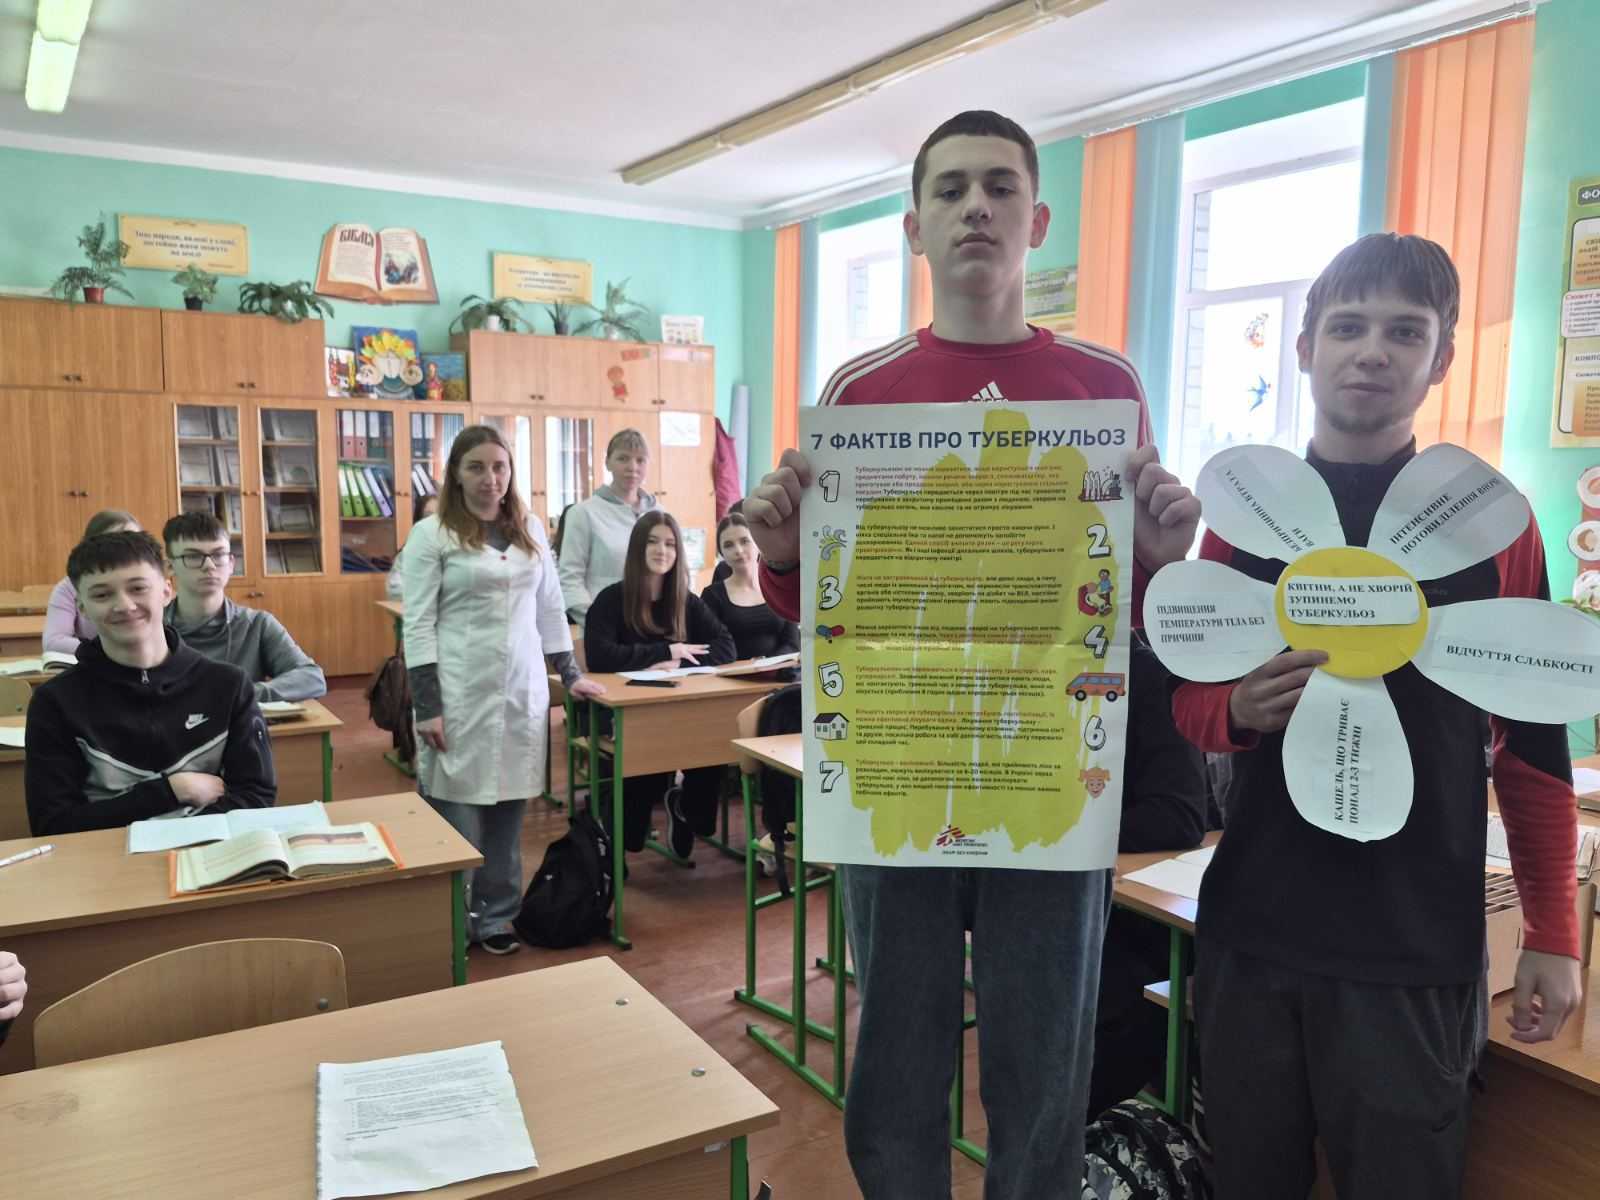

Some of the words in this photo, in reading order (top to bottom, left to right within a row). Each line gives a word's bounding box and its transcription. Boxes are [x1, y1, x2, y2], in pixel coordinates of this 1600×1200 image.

[810, 433, 823, 451] 7
[830, 431, 911, 450] ФАКТІВ
[919, 431, 962, 449] ПРО
[970, 428, 1126, 448] ТУБЕРКУЛЬОЗ
[1389, 492, 1453, 545] ІНТЕНСИВНЕ
[1400, 490, 1478, 554] ПОТОВИДІЛЕННЯ
[1087, 523, 1111, 559] 2
[1291, 527, 1315, 547] ВАГИ
[818, 575, 843, 611] 3
[1289, 595, 1357, 605] ЗУПИНЕМО
[1338, 584, 1347, 592] А
[1352, 584, 1364, 592] НЕ
[1367, 583, 1413, 593] ХВОРІЙ
[1156, 605, 1216, 615] ПІДВИЩЕННЯ
[1160, 618, 1223, 629] ТЕМПЕРАТУРИ
[1224, 617, 1247, 627] ТІЛА
[1248, 616, 1265, 626] БЕЗ
[1289, 608, 1375, 619] ТУБЕРКУЛЬОЗ
[1083, 624, 1108, 659] 4
[1161, 633, 1205, 643] ПРИЧИНИ
[1447, 645, 1511, 662] ВІДЧУТТЯ
[1515, 655, 1594, 674] СЛАБКОСТІ
[818, 661, 844, 698] 5
[1084, 714, 1107, 751] 6
[1337, 698, 1350, 743] ТРИВАЄ
[1336, 745, 1347, 767] ЩО
[1350, 725, 1362, 764] ТИЖНІ
[819, 760, 843, 793] 7
[1349, 766, 1359, 782] 2-3
[1334, 768, 1345, 821] КАШЕЛЬ,
[1349, 783, 1359, 824] ПОНАД
